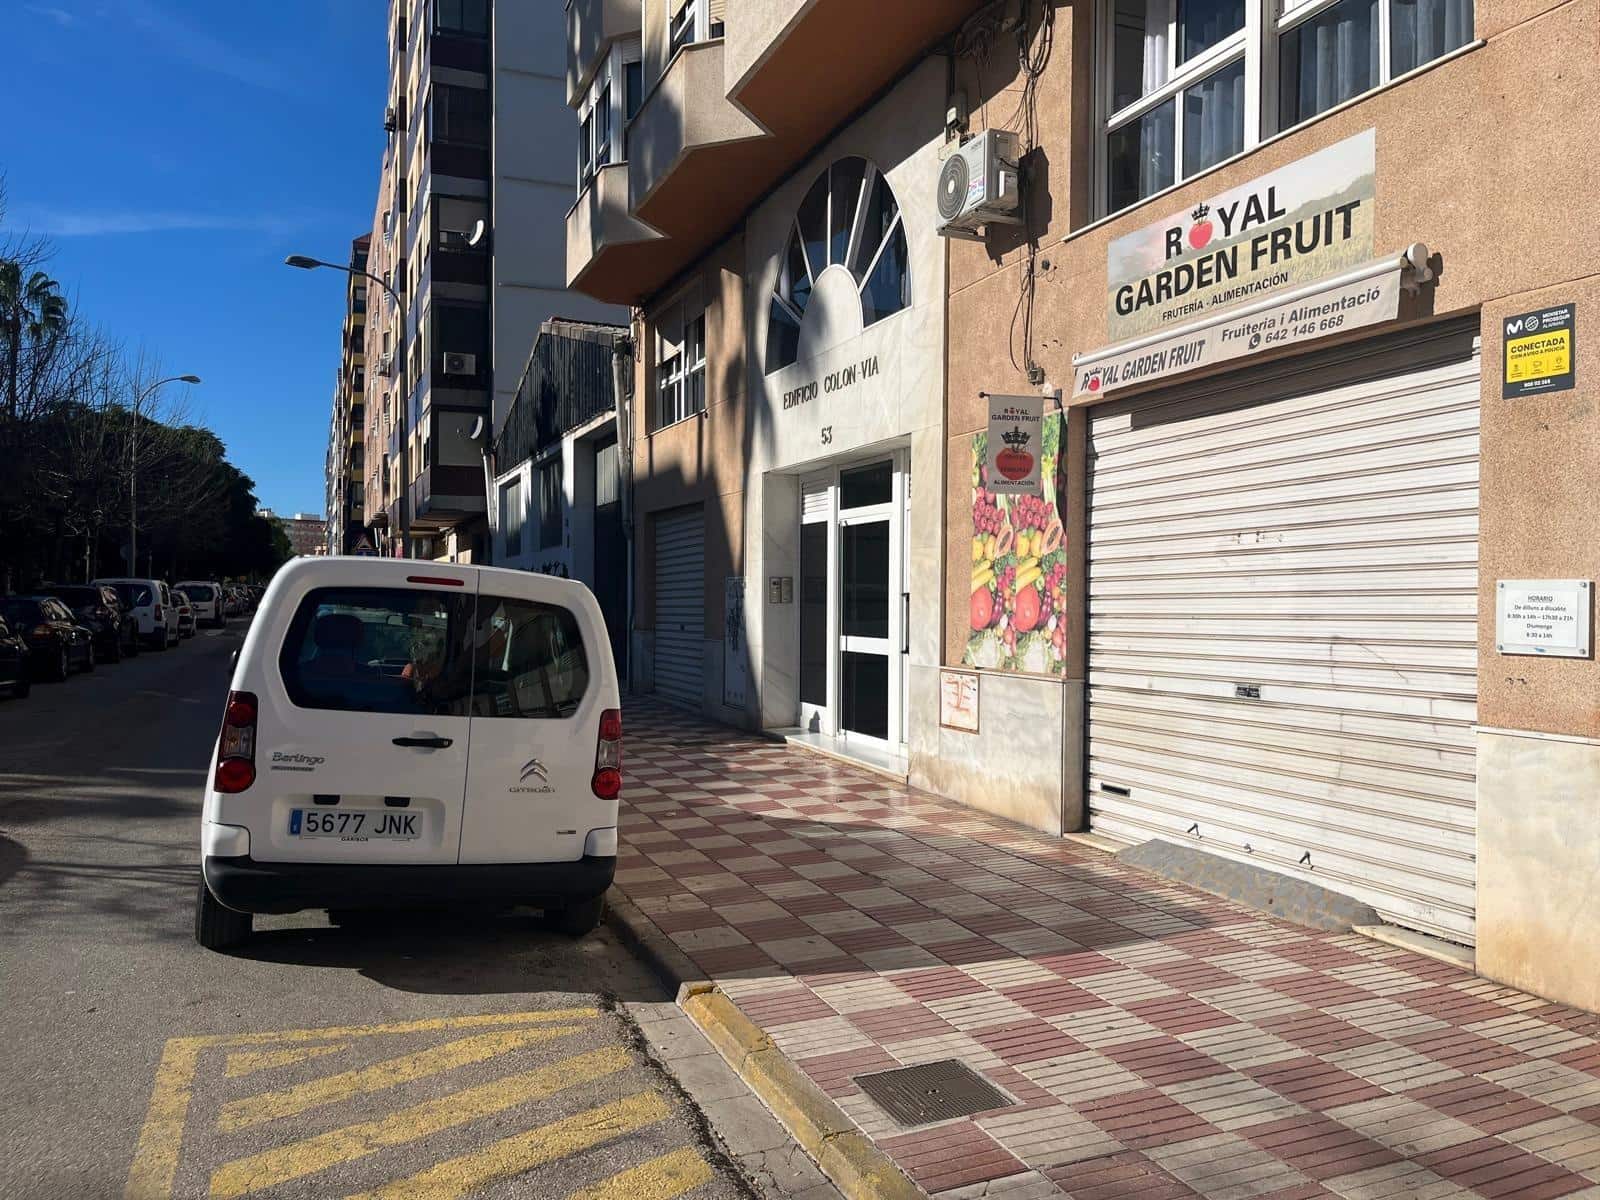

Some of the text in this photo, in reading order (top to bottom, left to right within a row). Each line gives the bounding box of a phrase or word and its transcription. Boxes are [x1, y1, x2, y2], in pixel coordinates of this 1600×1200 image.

[1115, 199, 1361, 317] GARDEN FRUIT
[1162, 299, 1204, 321] FRUTERÍA
[1211, 272, 1289, 306] ALIMENTACIÓN
[1221, 286, 1381, 342] Fruiteria i Alimentació
[1265, 314, 1345, 344] 642 146 668
[1510, 337, 1566, 354] CONECTADA
[1121, 350, 1169, 382] GARDEN
[1168, 340, 1206, 369] FRUIT
[783, 380, 819, 411] EDIFICIO
[992, 414, 1041, 423] GARDEN FRUIT
[821, 425, 833, 445] 53
[271, 751, 326, 766] Berlingo
[306, 812, 417, 836] 5677 JNK
